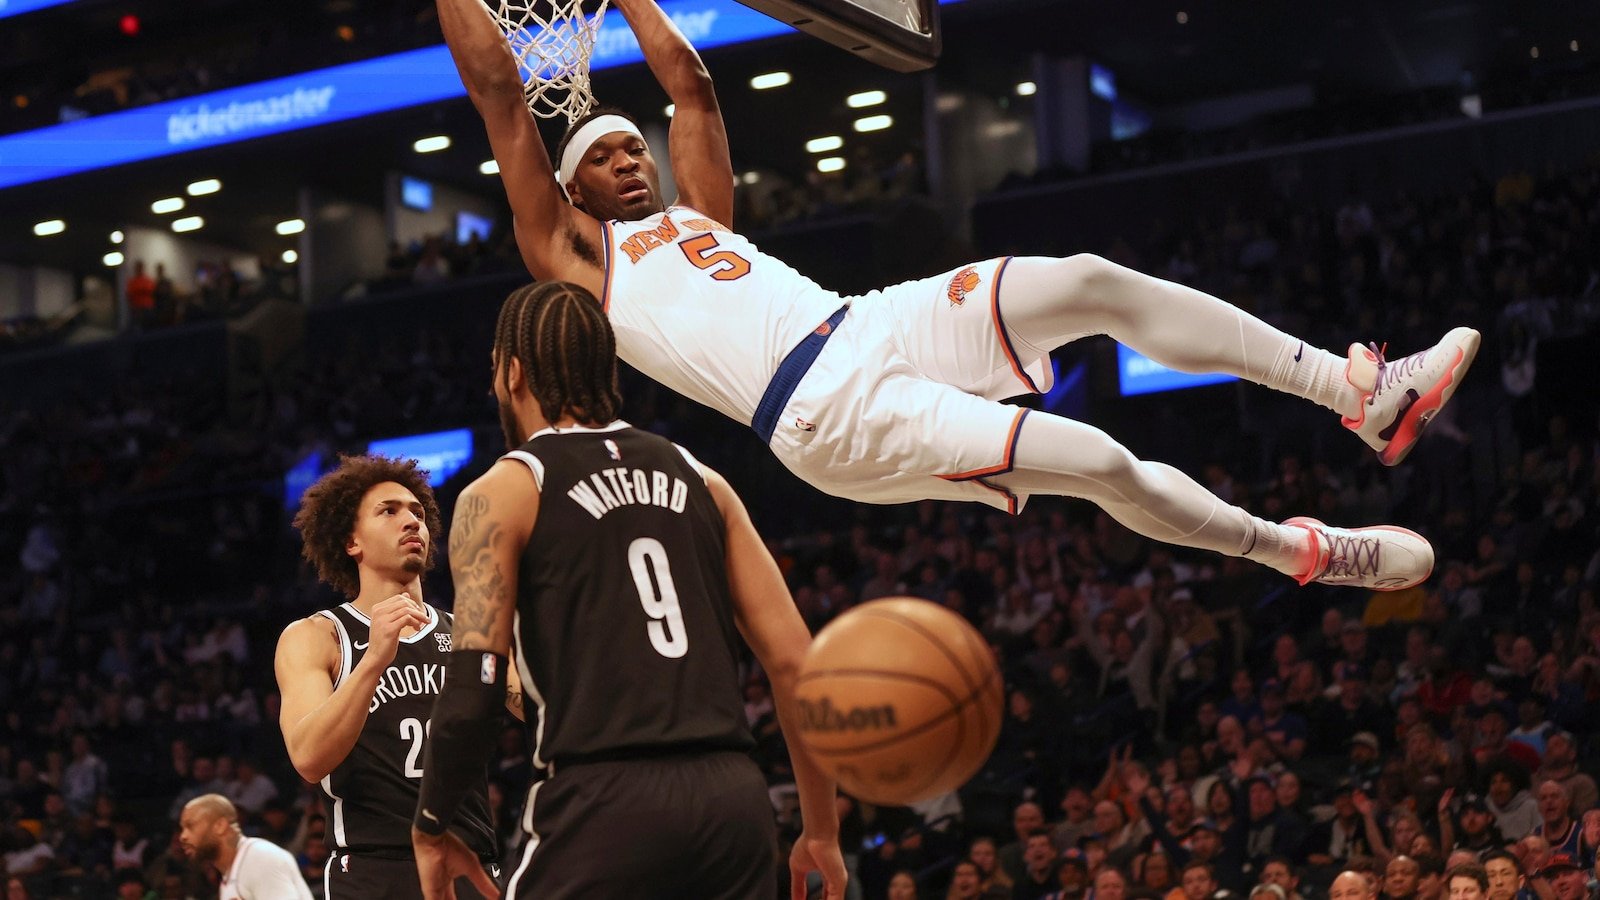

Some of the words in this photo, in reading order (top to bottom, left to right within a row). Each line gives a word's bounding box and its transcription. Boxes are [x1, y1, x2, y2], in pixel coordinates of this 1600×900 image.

[167, 85, 335, 145] ticketmaster
[619, 215, 680, 265] NEW
[678, 232, 752, 281] 5
[567, 467, 689, 520] WATFORD
[628, 537, 689, 659] 9
[399, 717, 433, 779] 2
